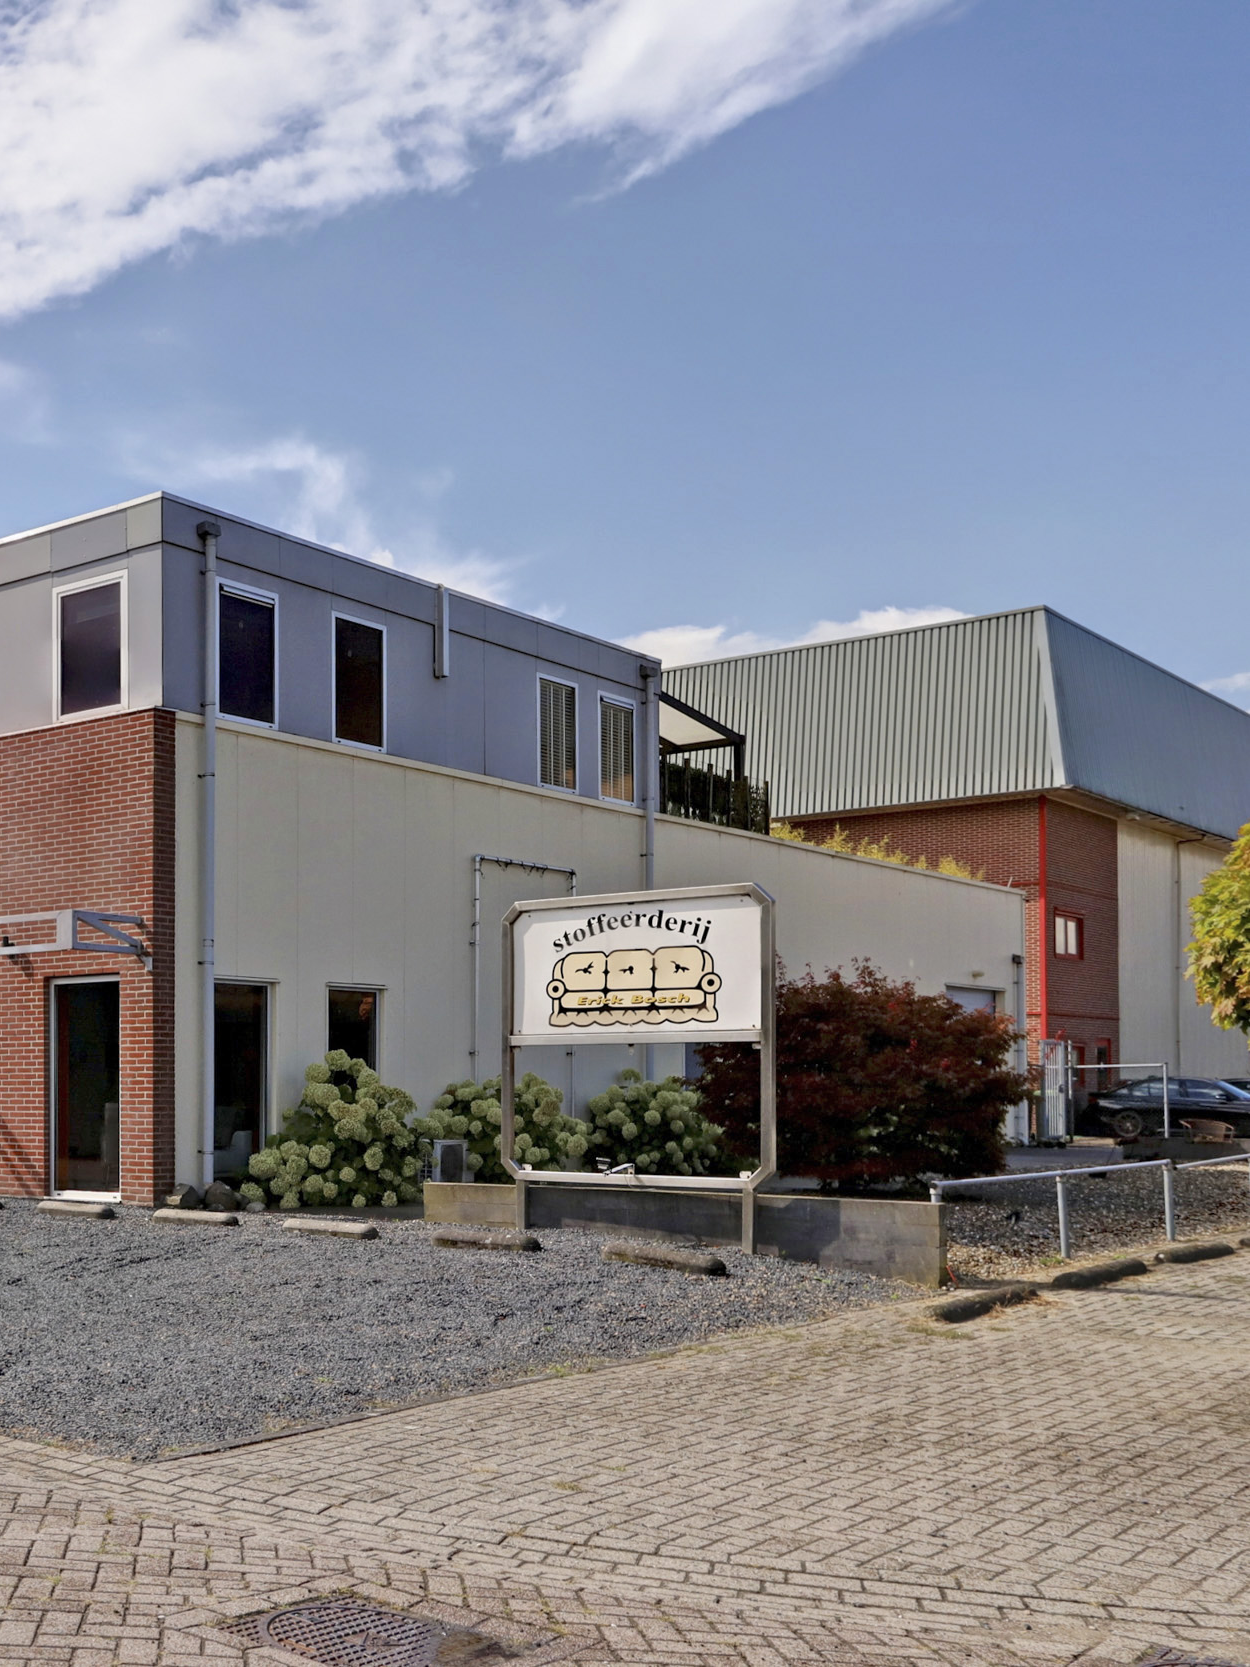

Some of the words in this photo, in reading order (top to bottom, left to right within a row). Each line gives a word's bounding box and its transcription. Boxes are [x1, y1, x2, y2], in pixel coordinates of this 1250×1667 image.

[553, 909, 712, 953] stoffeerderij
[577, 995, 624, 1006] Erick
[631, 993, 691, 1004] Bosch
